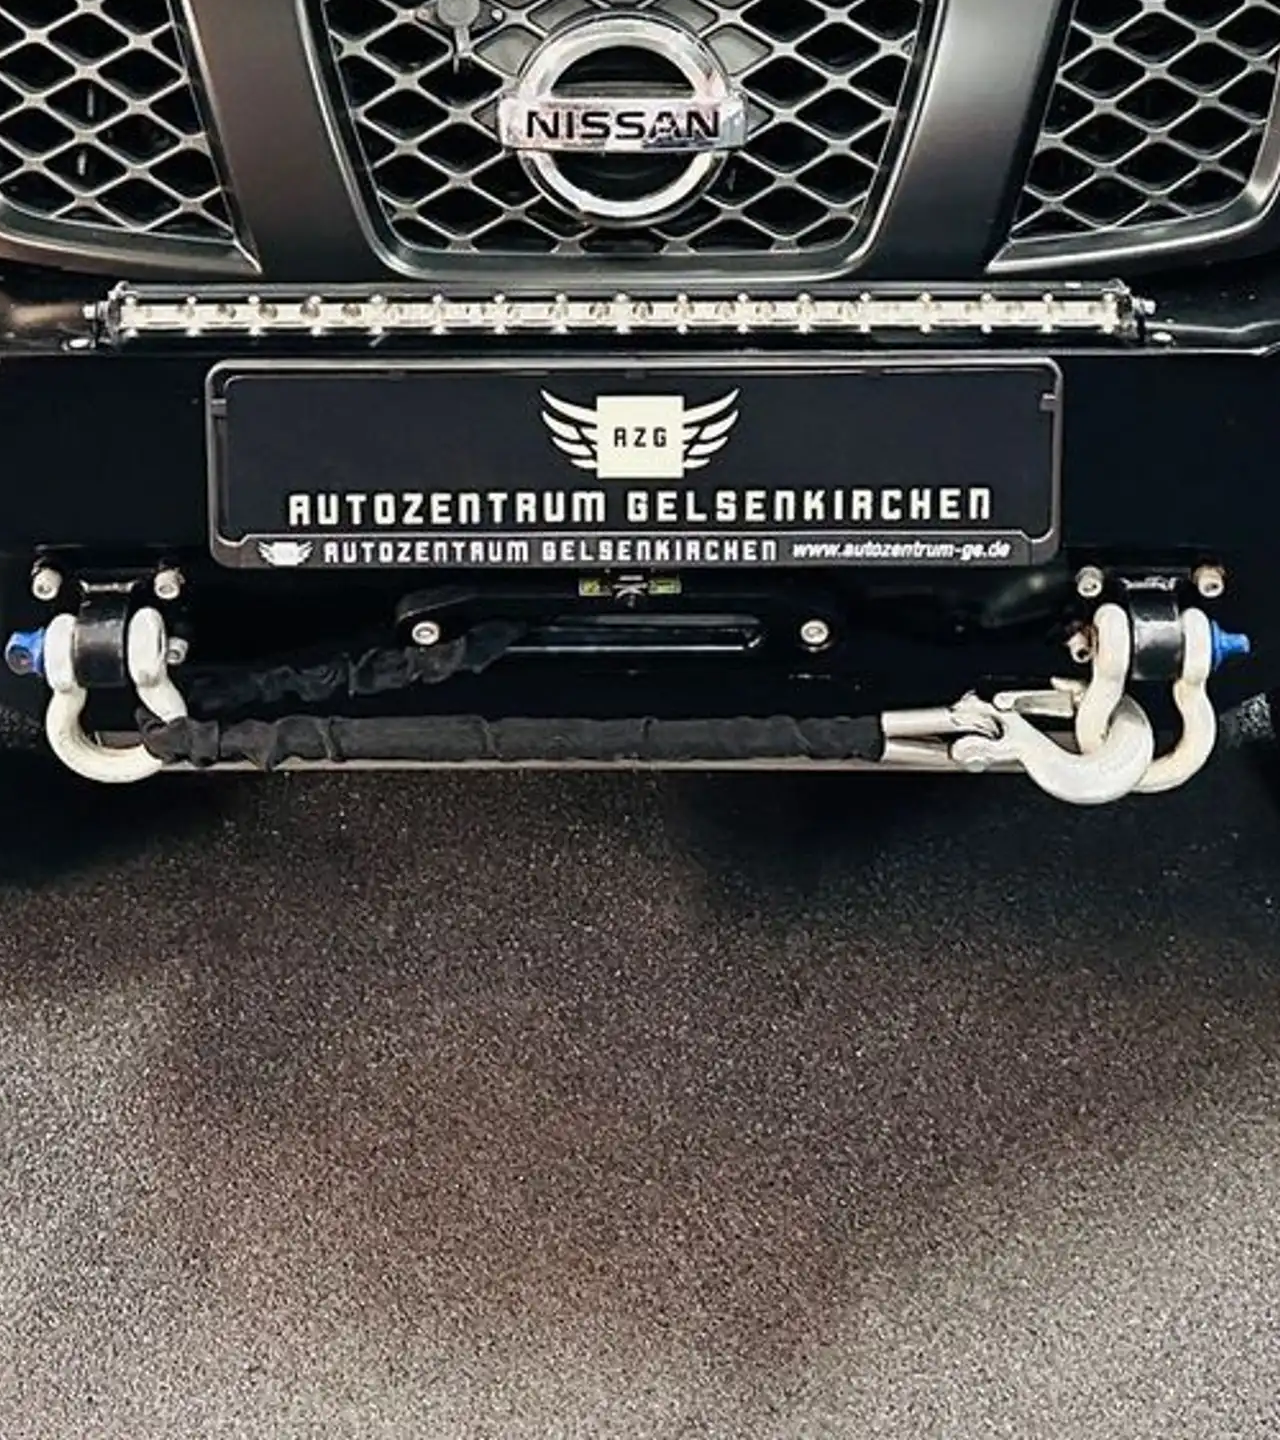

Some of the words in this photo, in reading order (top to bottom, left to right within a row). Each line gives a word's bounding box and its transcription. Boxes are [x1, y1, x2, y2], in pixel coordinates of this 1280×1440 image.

[526, 110, 719, 139] NISSAN
[614, 426, 667, 448] AZG
[289, 491, 605, 526] AUTOZENTRUM
[627, 487, 990, 523] GELSENKIRCHEN
[324, 541, 529, 564] AUTOZENTRUM
[542, 540, 777, 563] GELSENKIRCHEN
[792, 540, 1012, 562] www.autozentrum-ge.de
